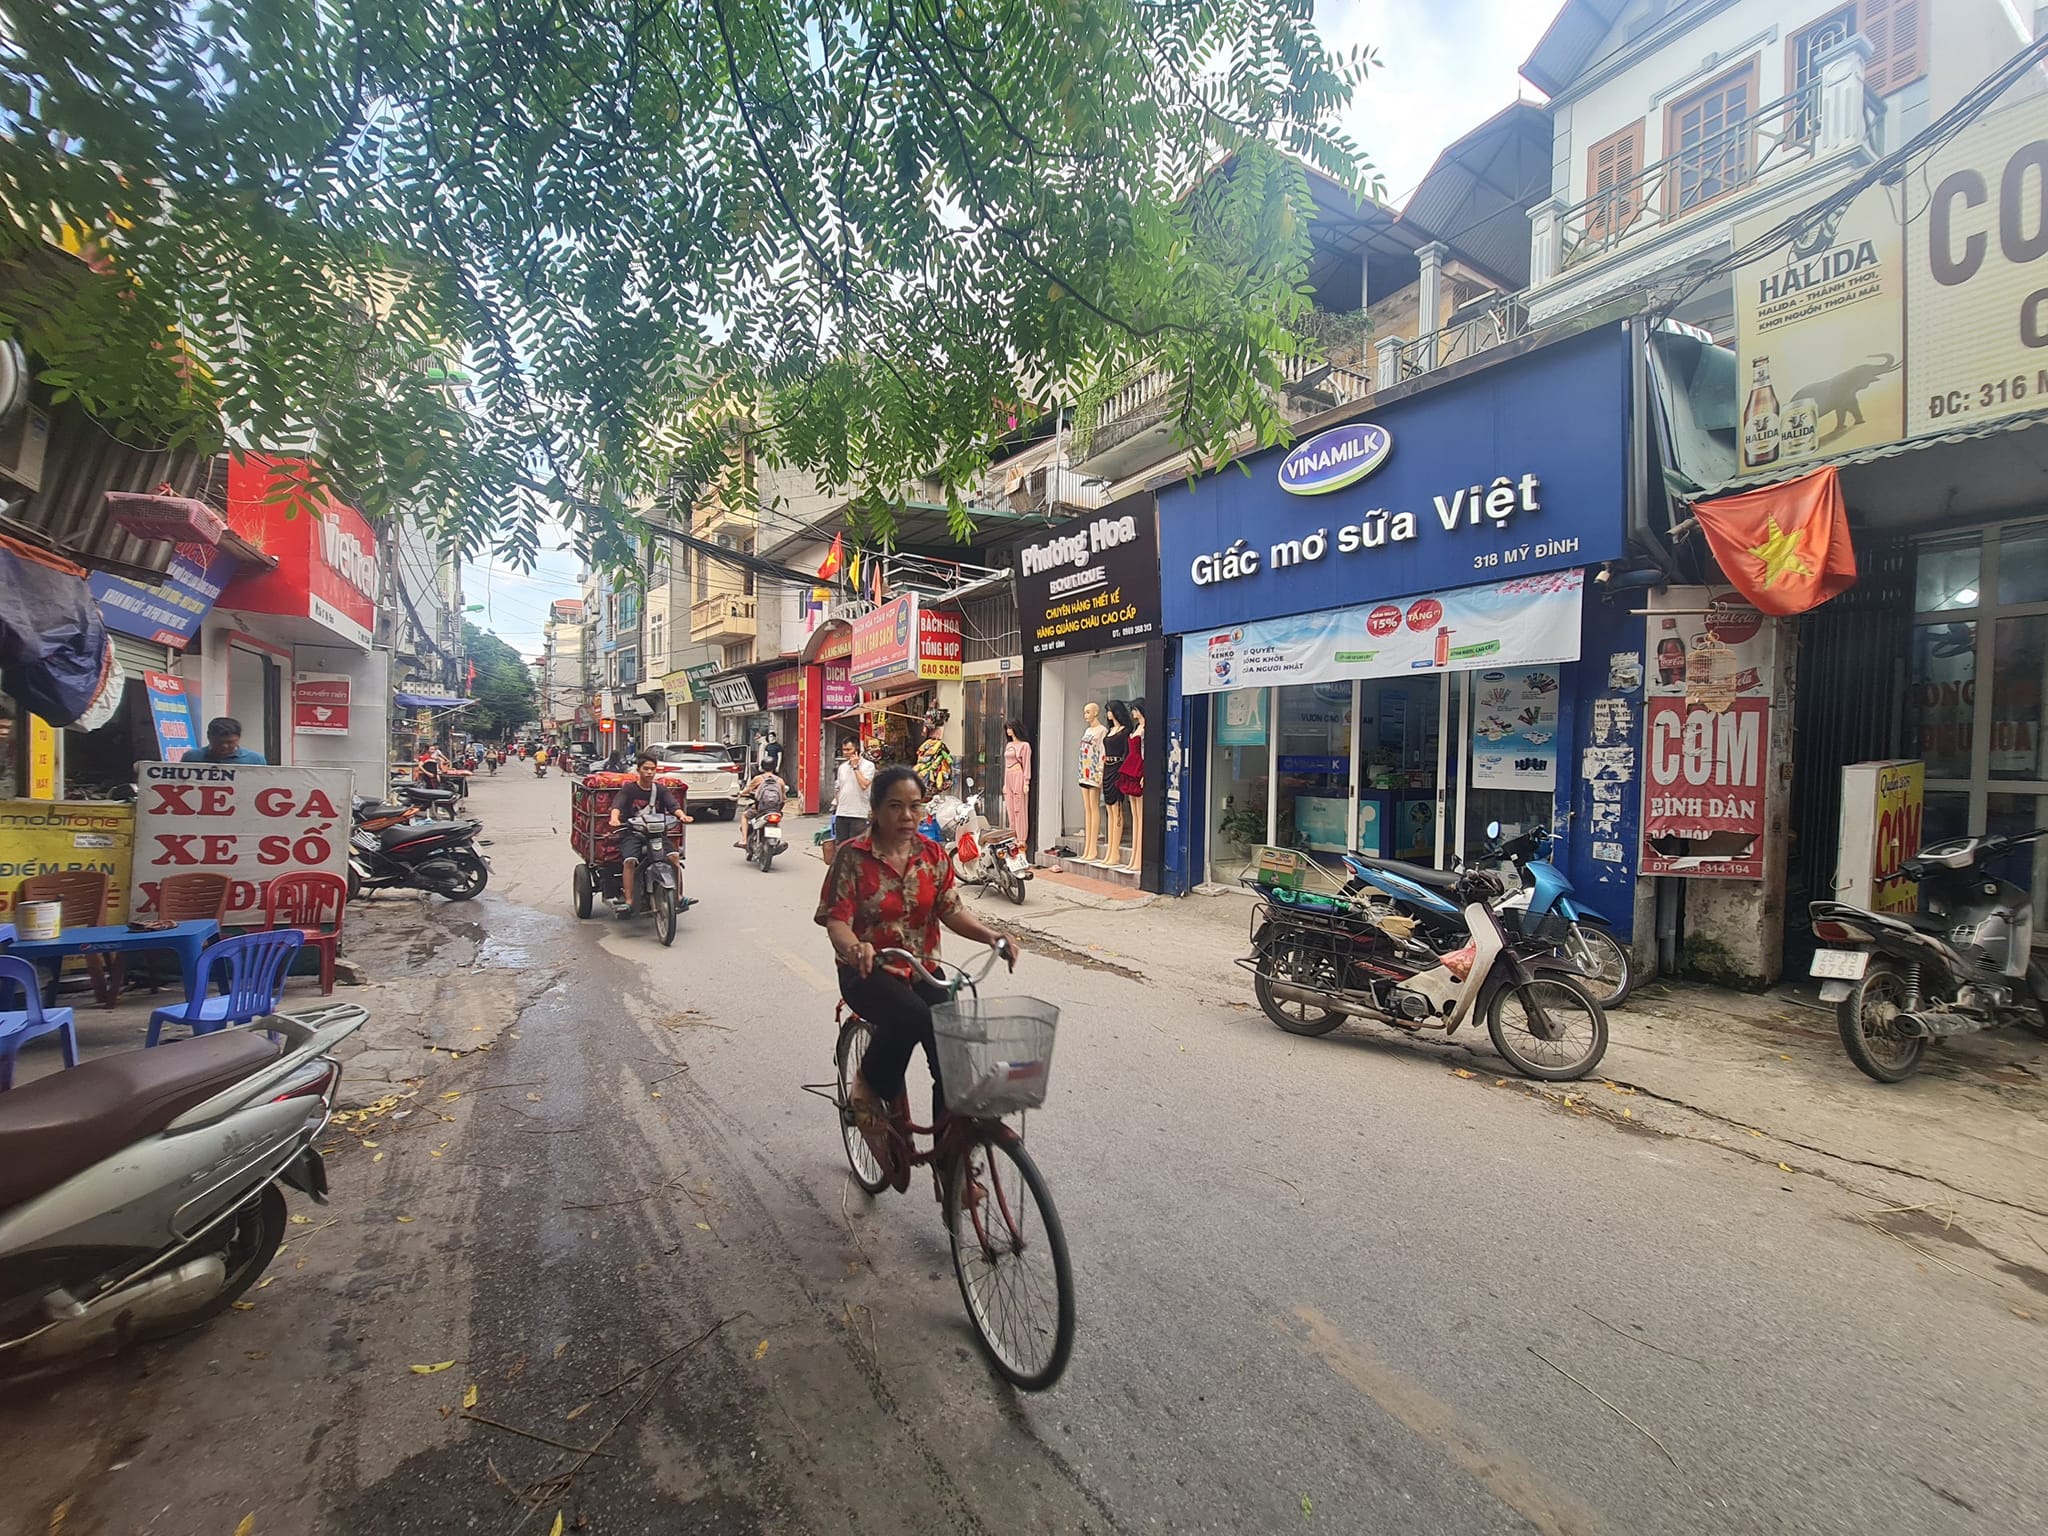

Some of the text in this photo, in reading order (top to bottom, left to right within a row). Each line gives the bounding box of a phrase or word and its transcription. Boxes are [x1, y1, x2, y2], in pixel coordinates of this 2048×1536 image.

[1760, 240, 1879, 304] HALIDA
[1758, 300, 1797, 318] HALIDA
[1929, 390, 1970, 418] ĐC:
[1979, 374, 2027, 408] 316
[1745, 428, 1779, 444] HALIDA
[1781, 425, 1815, 441] HALIDA
[1286, 431, 1381, 480] VINAMILK
[1190, 473, 1541, 587] Giấc mơ sữa Việt
[1021, 516, 1136, 577] Phương Hoa
[1473, 537, 1580, 570] 318 MỸ ĐÌNH
[1049, 566, 1106, 594] BOUTIQUE
[1046, 586, 1121, 620] CHUYÊN HÀNG THIẾT KẾ
[921, 615, 942, 632] BÁCH
[1036, 624, 1055, 639] HÀNG
[1080, 614, 1100, 630] CHÂU
[1101, 611, 1119, 625] CAO
[1119, 603, 1137, 621] CẤP
[1372, 617, 1398, 629] 15%
[921, 636, 960, 660] TỔNG HỢP
[1211, 650, 1234, 659] KENKO
[921, 664, 937, 676] GẠO
[939, 664, 960, 677] SẠCH
[1652, 709, 1760, 786] CƠM
[147, 766, 236, 782] CHUYÊN
[148, 784, 339, 818] XE GA
[1651, 792, 1756, 819] BÌNH DÂN
[0, 805, 119, 828] mobifone
[151, 822, 333, 865] XE SỐ
